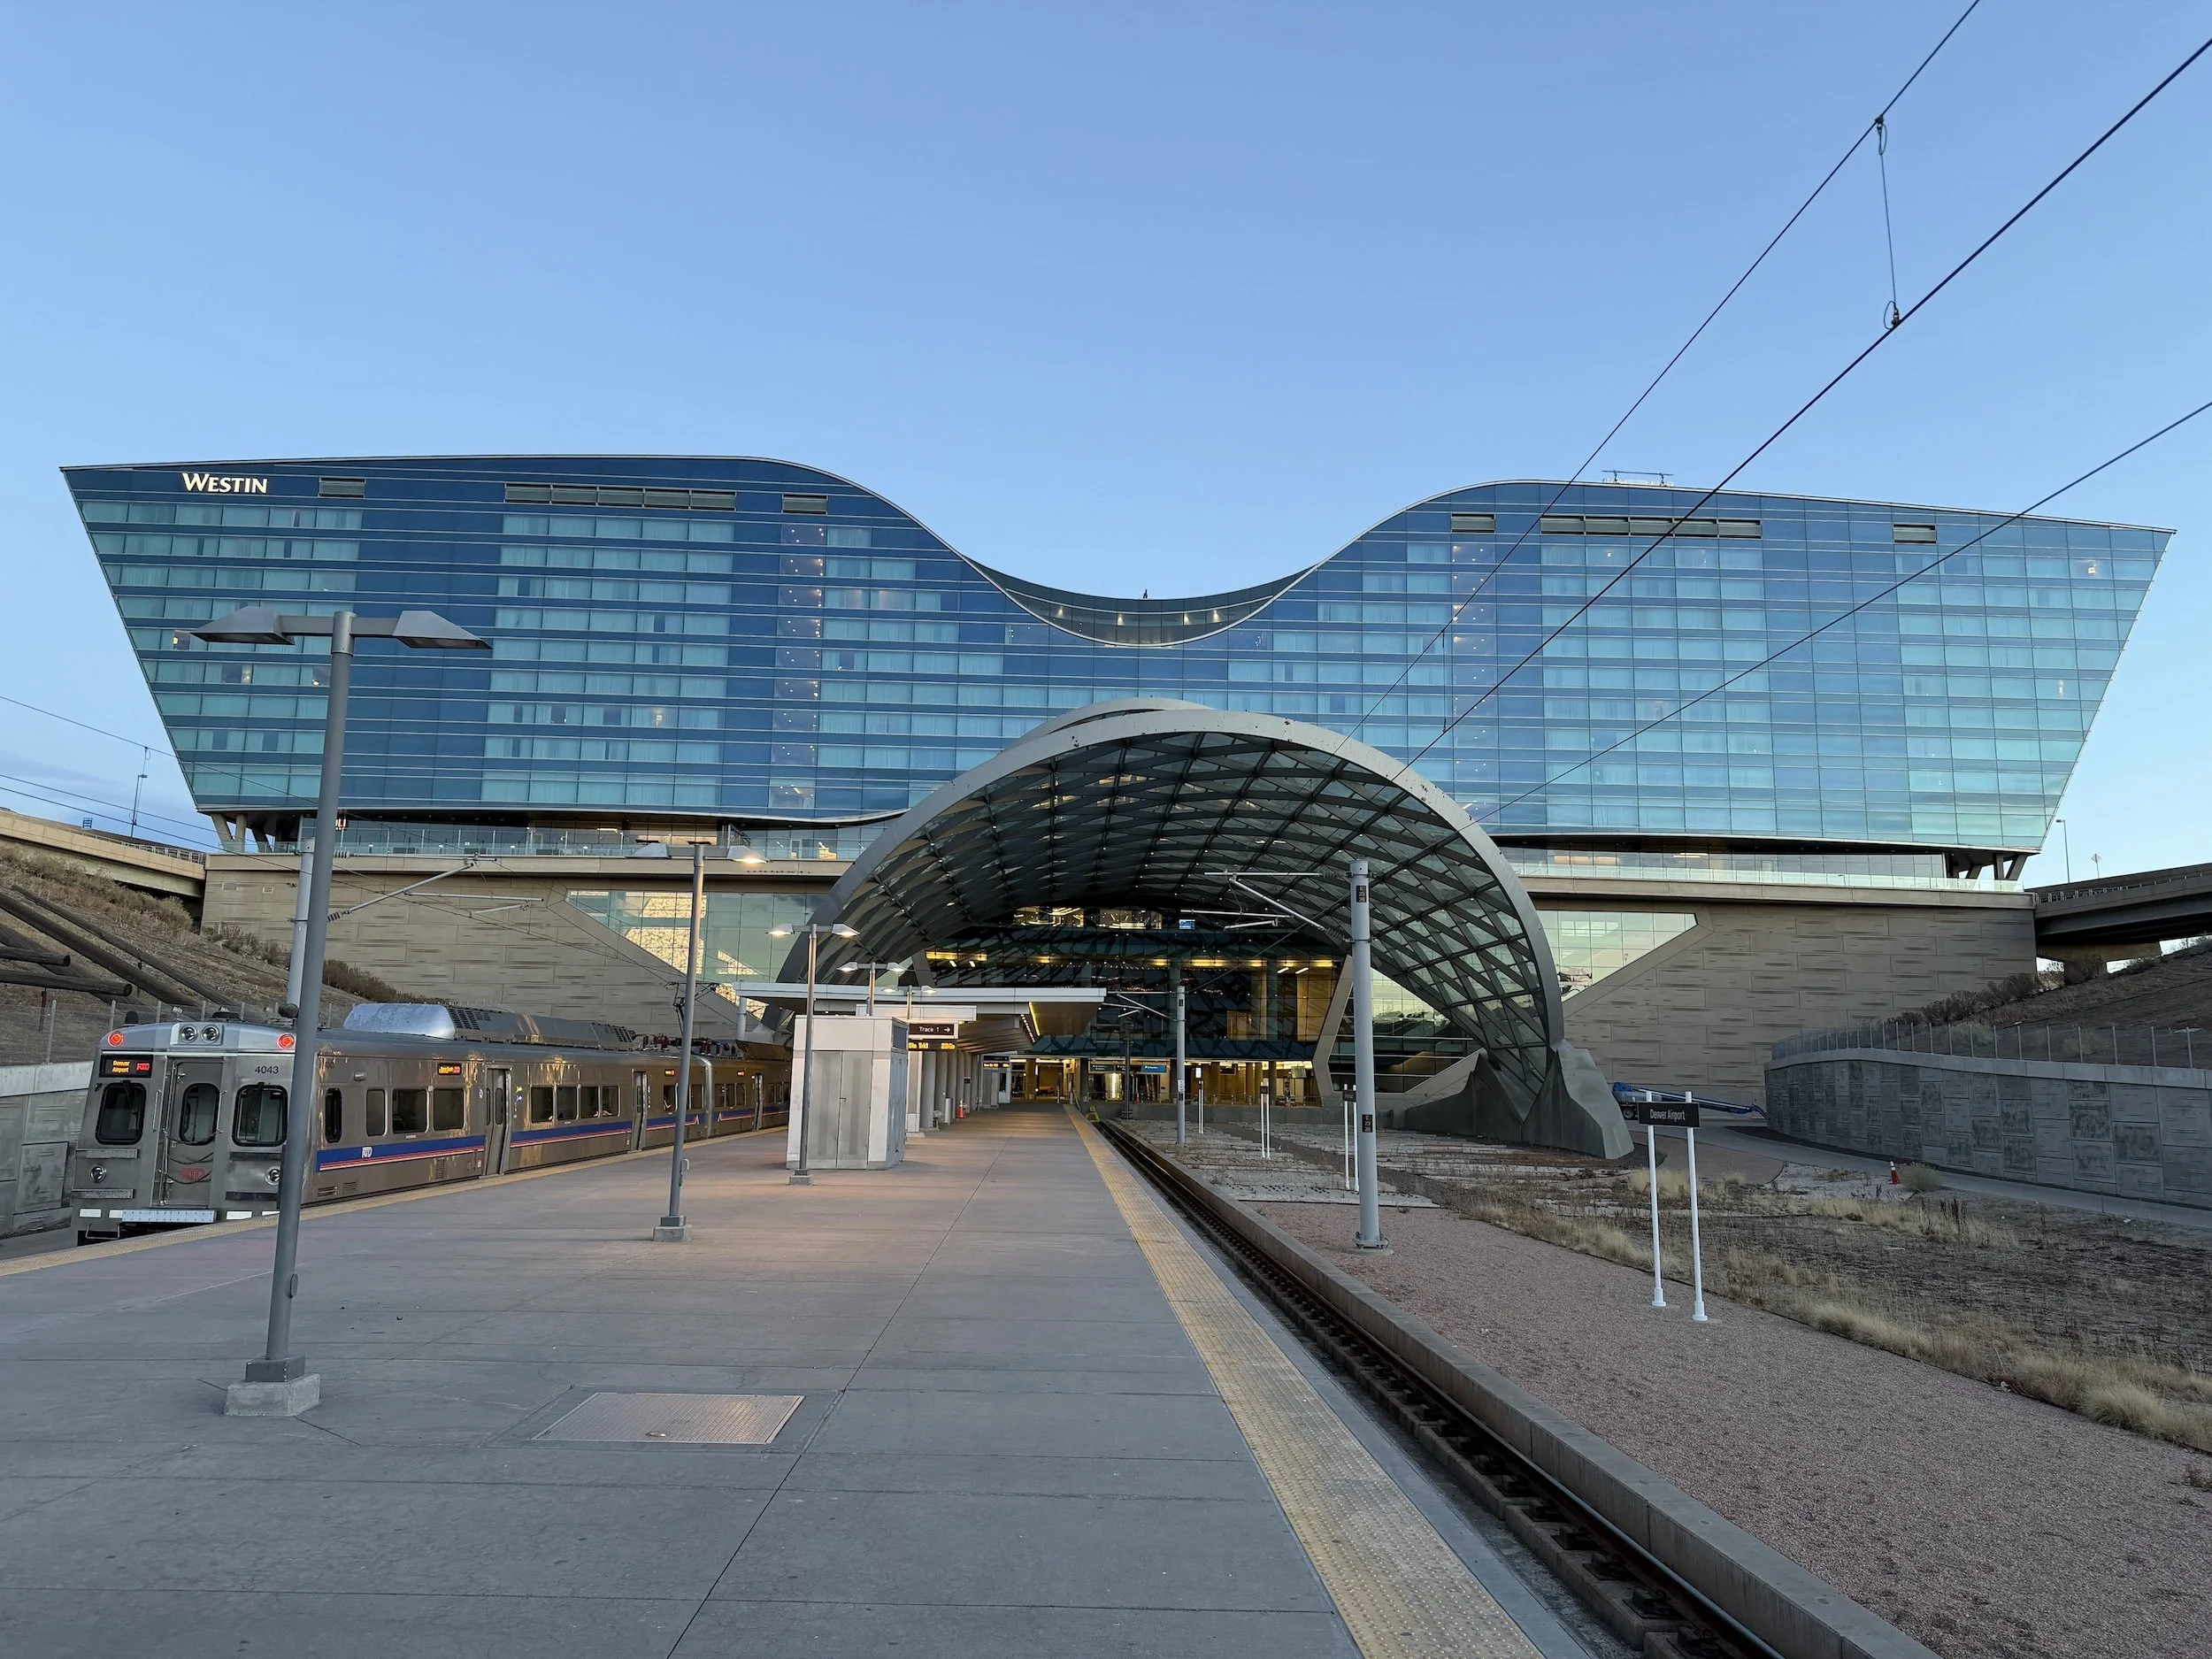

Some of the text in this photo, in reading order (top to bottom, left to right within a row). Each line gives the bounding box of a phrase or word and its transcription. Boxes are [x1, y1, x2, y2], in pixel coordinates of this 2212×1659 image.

[181, 472, 268, 494] WESTIN
[254, 1065, 280, 1074] 4043
[1649, 1109, 1686, 1122] Denver Airport
